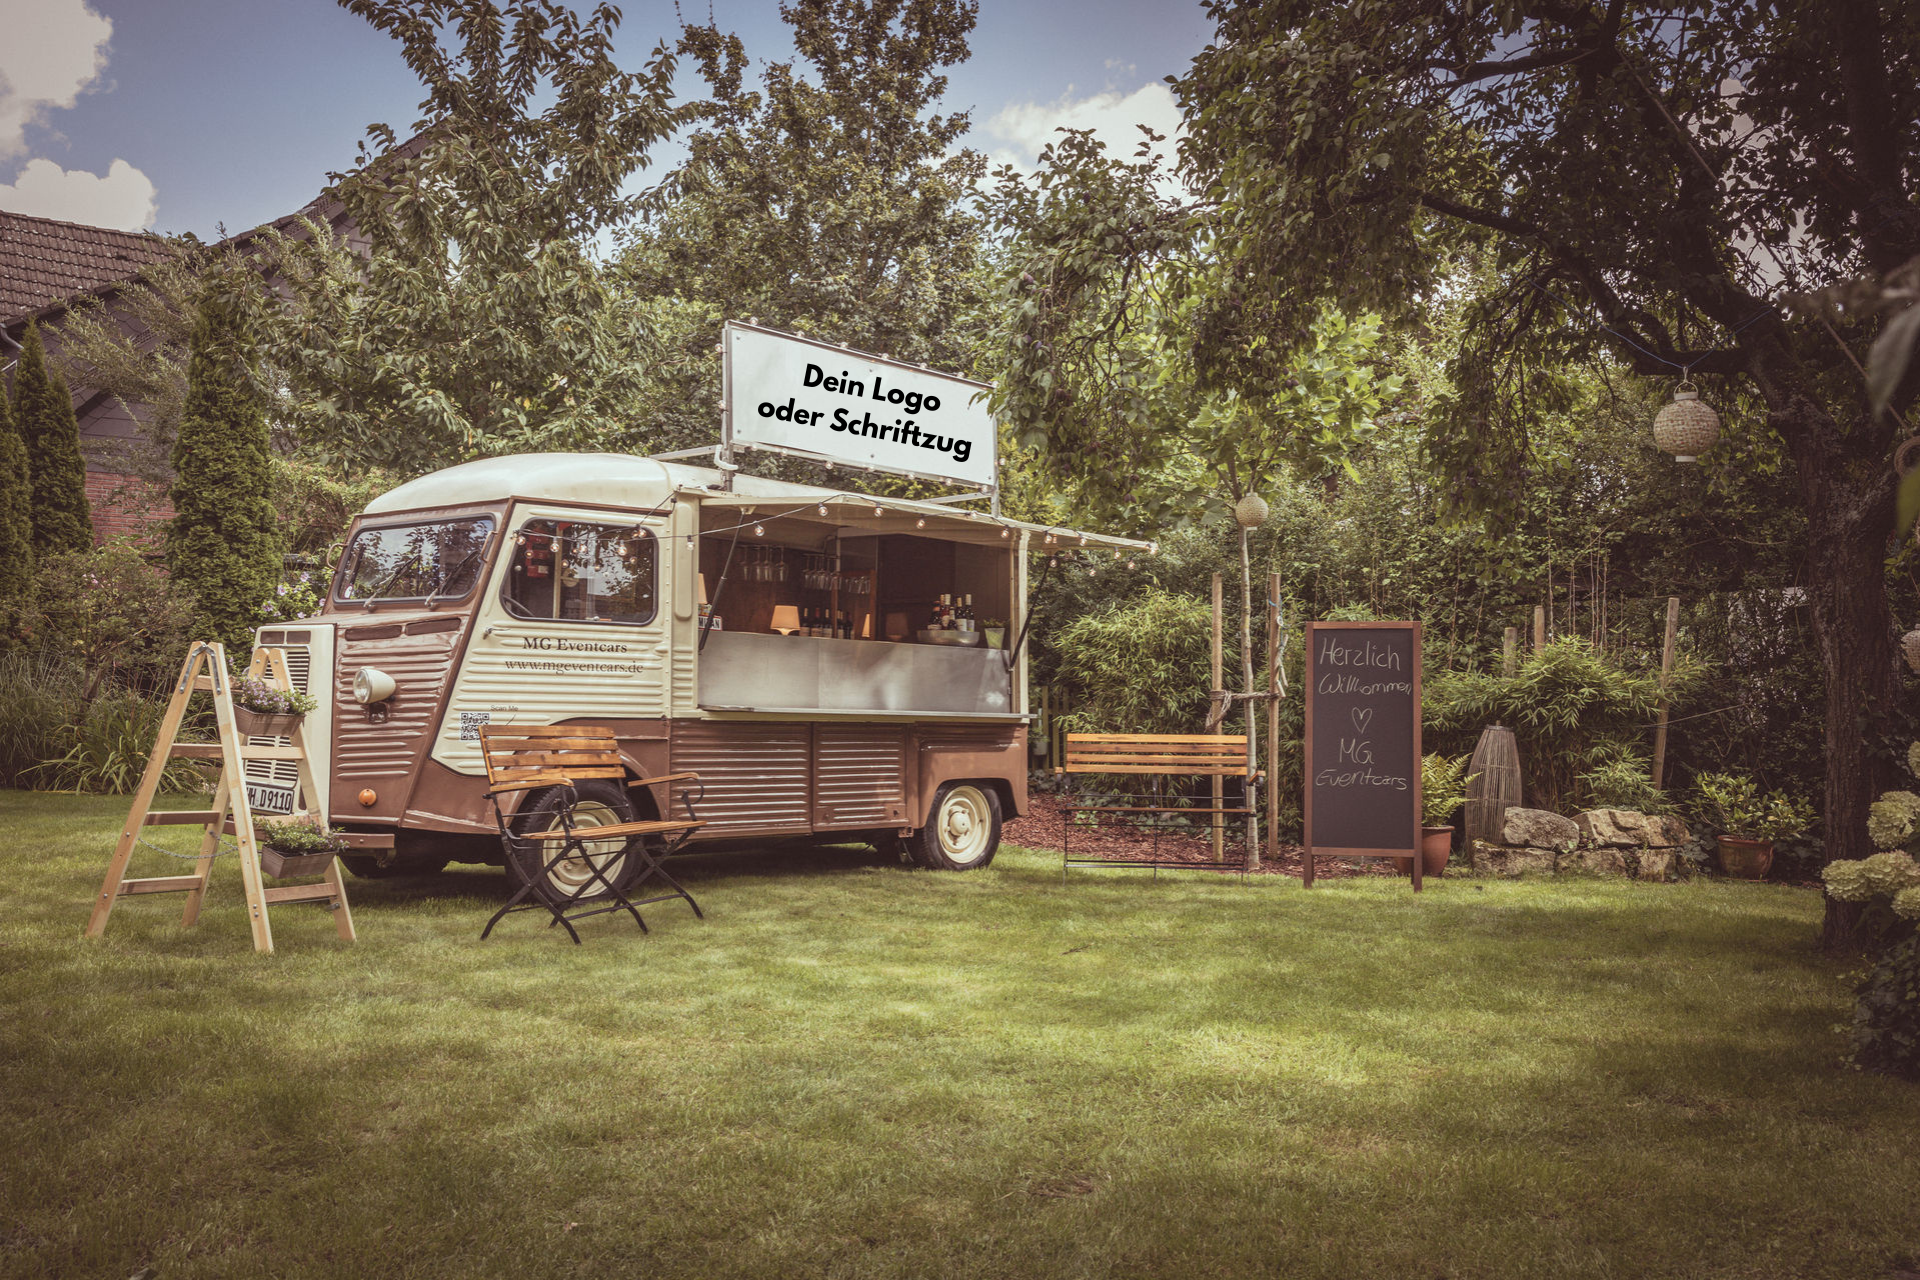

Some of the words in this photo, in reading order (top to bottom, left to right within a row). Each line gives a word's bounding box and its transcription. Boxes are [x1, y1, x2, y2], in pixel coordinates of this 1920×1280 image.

[803, 363, 864, 397] Dein
[872, 377, 941, 414] Logo
[758, 398, 824, 426] oder
[829, 408, 972, 462] Schriftzug
[523, 637, 551, 650] MG
[557, 638, 627, 653] Eventcars
[1319, 637, 1400, 671] Herzlich
[505, 660, 643, 675] www.mgeventcars.de
[1318, 672, 1412, 696] Willkommen
[1339, 738, 1375, 764] MG
[1315, 767, 1408, 790] Eventcars
